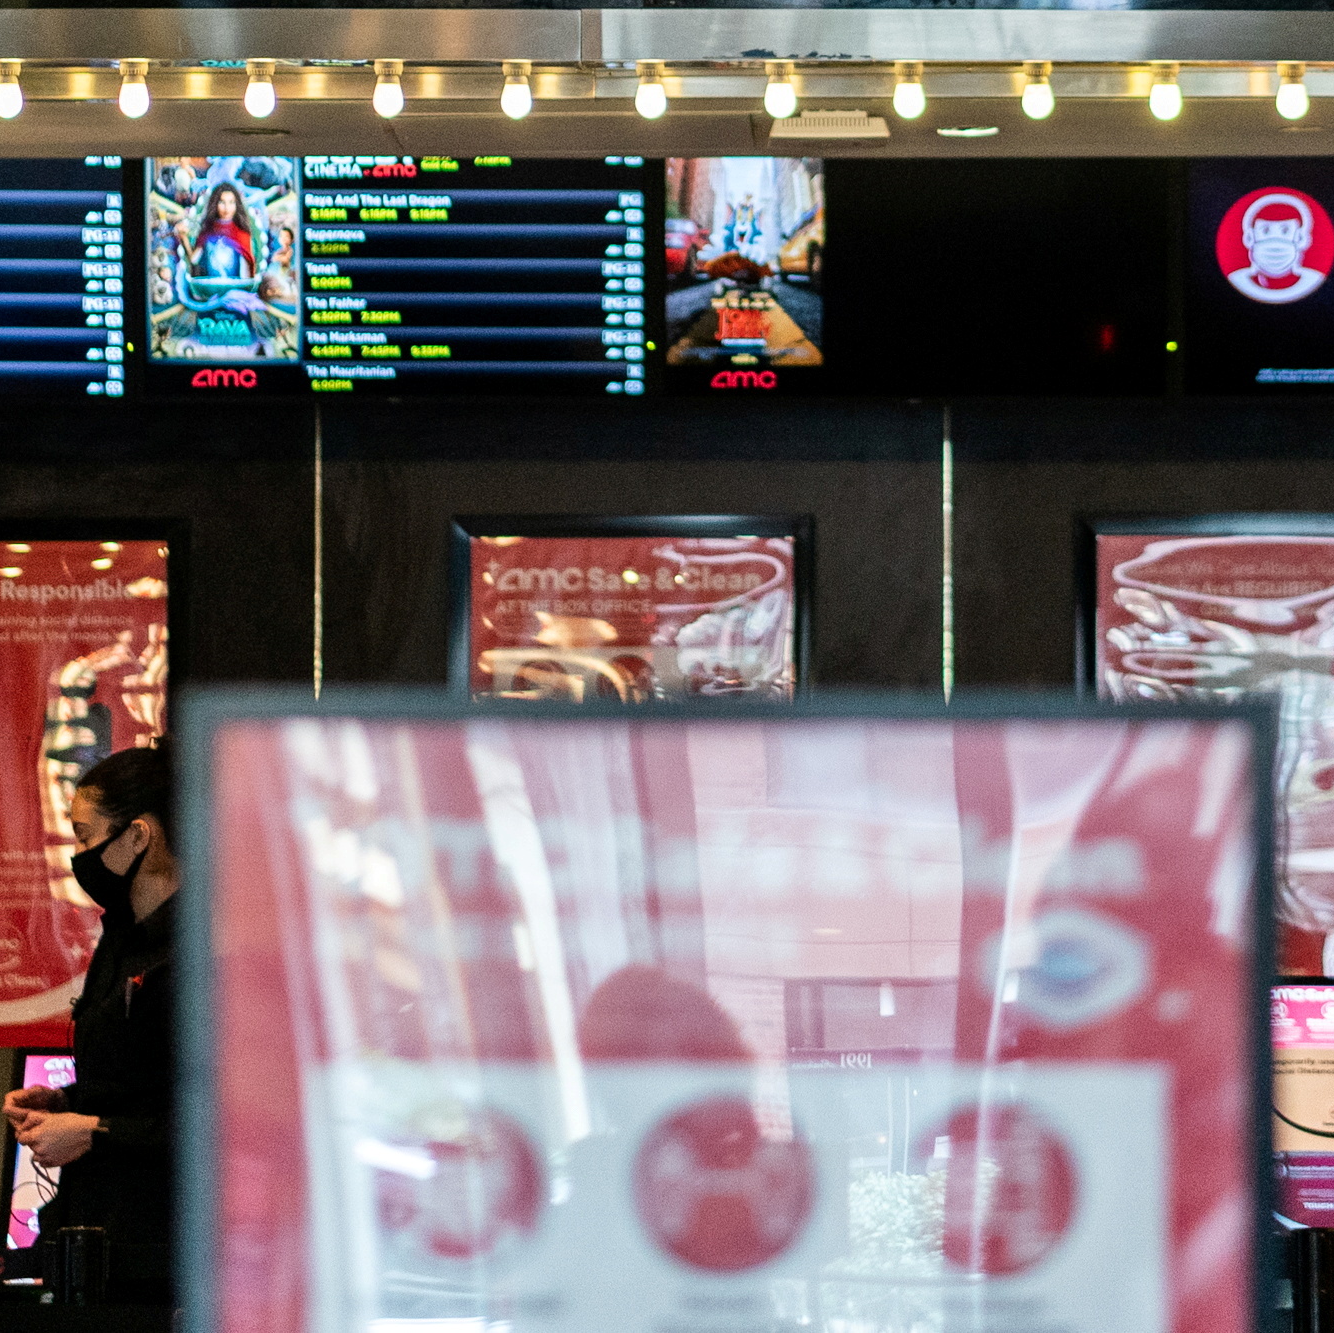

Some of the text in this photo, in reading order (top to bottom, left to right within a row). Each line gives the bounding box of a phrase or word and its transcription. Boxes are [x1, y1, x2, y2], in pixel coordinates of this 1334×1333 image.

[305, 163, 363, 179] CINEMA
[305, 193, 452, 208] Raya And The Last Dragon
[305, 228, 366, 242] Supernova
[305, 262, 338, 276] Tenet
[305, 296, 367, 310] The Father
[306, 330, 387, 344] The Marksman
[306, 365, 396, 380] The Mauritanian
[656, 567, 675, 590] &
[681, 565, 763, 590] Clean
[495, 599, 653, 613] AT THE BOX OFFICE
